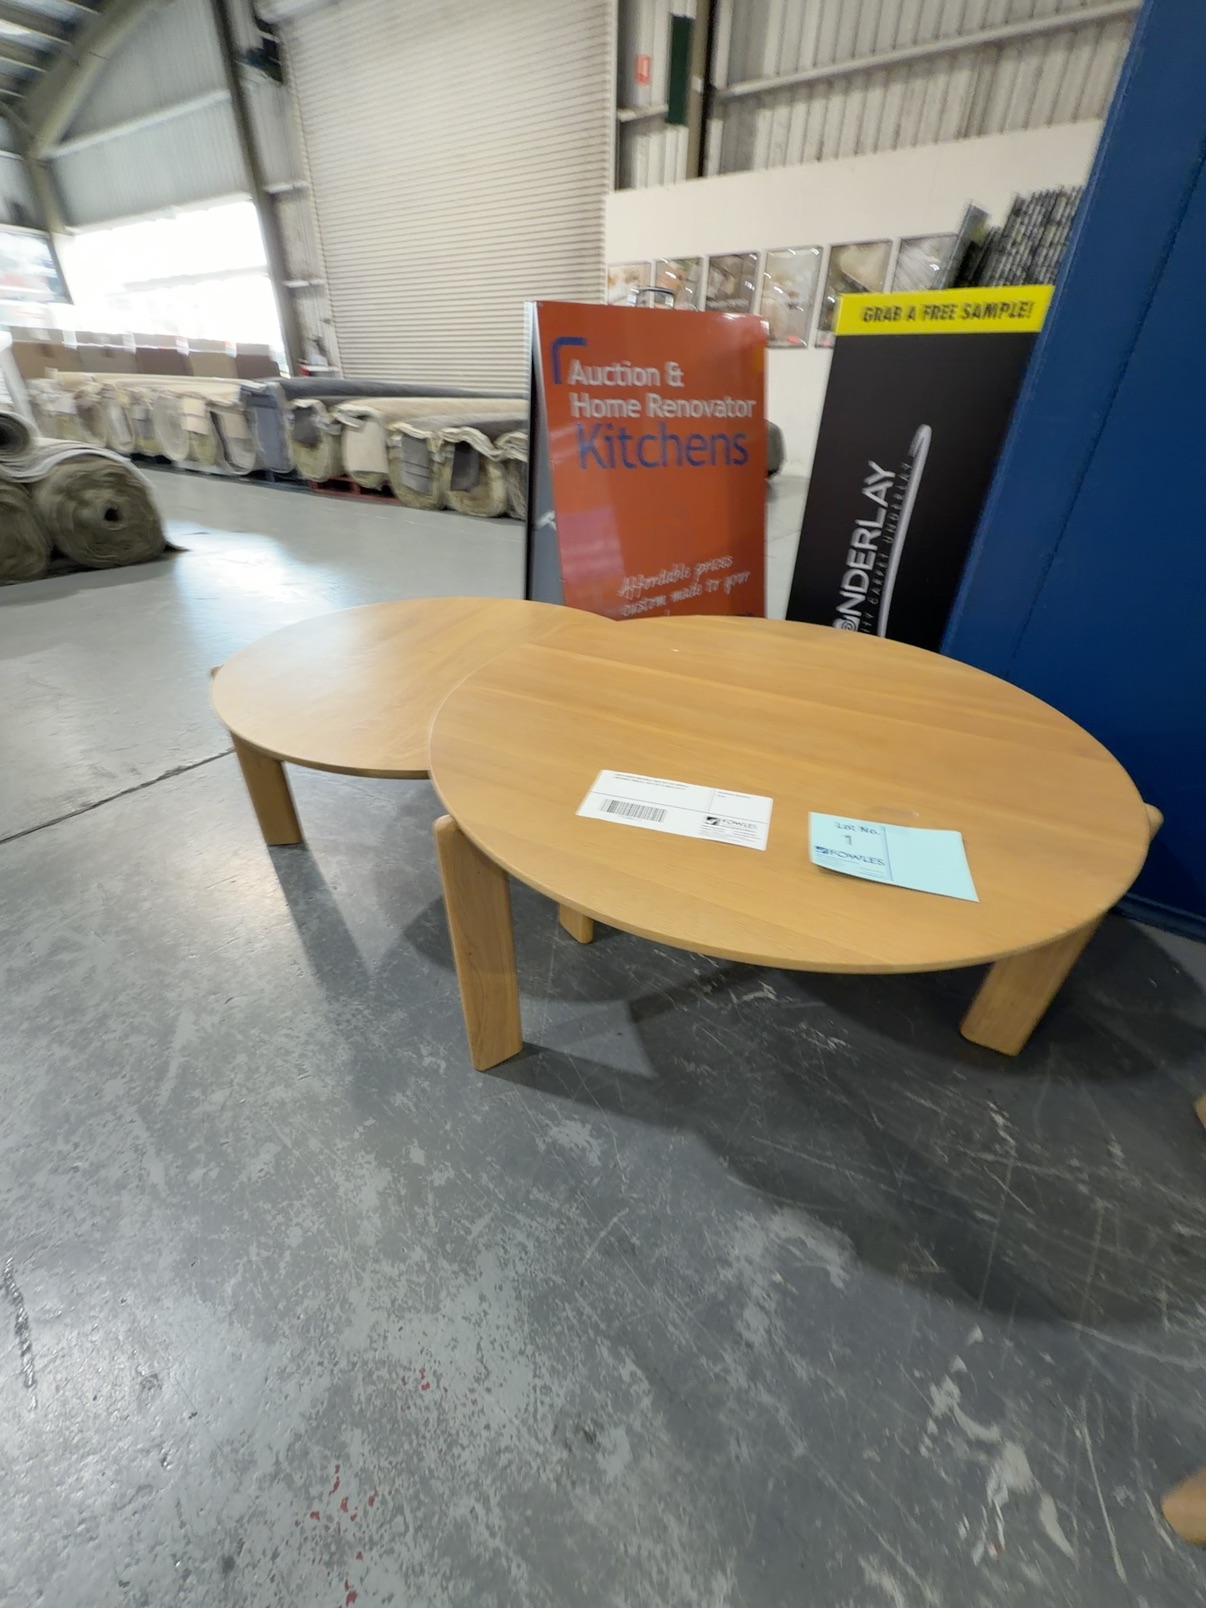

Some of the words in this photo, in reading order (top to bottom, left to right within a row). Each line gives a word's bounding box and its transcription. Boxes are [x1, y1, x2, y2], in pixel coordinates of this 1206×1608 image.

[862, 305, 902, 323] GRAB
[906, 305, 916, 321] A
[922, 303, 957, 321] FREE
[961, 301, 1034, 320] SAMPLE!
[568, 359, 660, 387] Auction
[666, 360, 685, 387] &
[568, 392, 642, 418] Home
[645, 392, 757, 418] Renovator
[576, 420, 749, 470] Kitchens
[617, 563, 692, 599] Affordable
[671, 583, 703, 602] made
[706, 578, 721, 592] to
[723, 571, 751, 594] your
[830, 849, 886, 866] FOWLES
